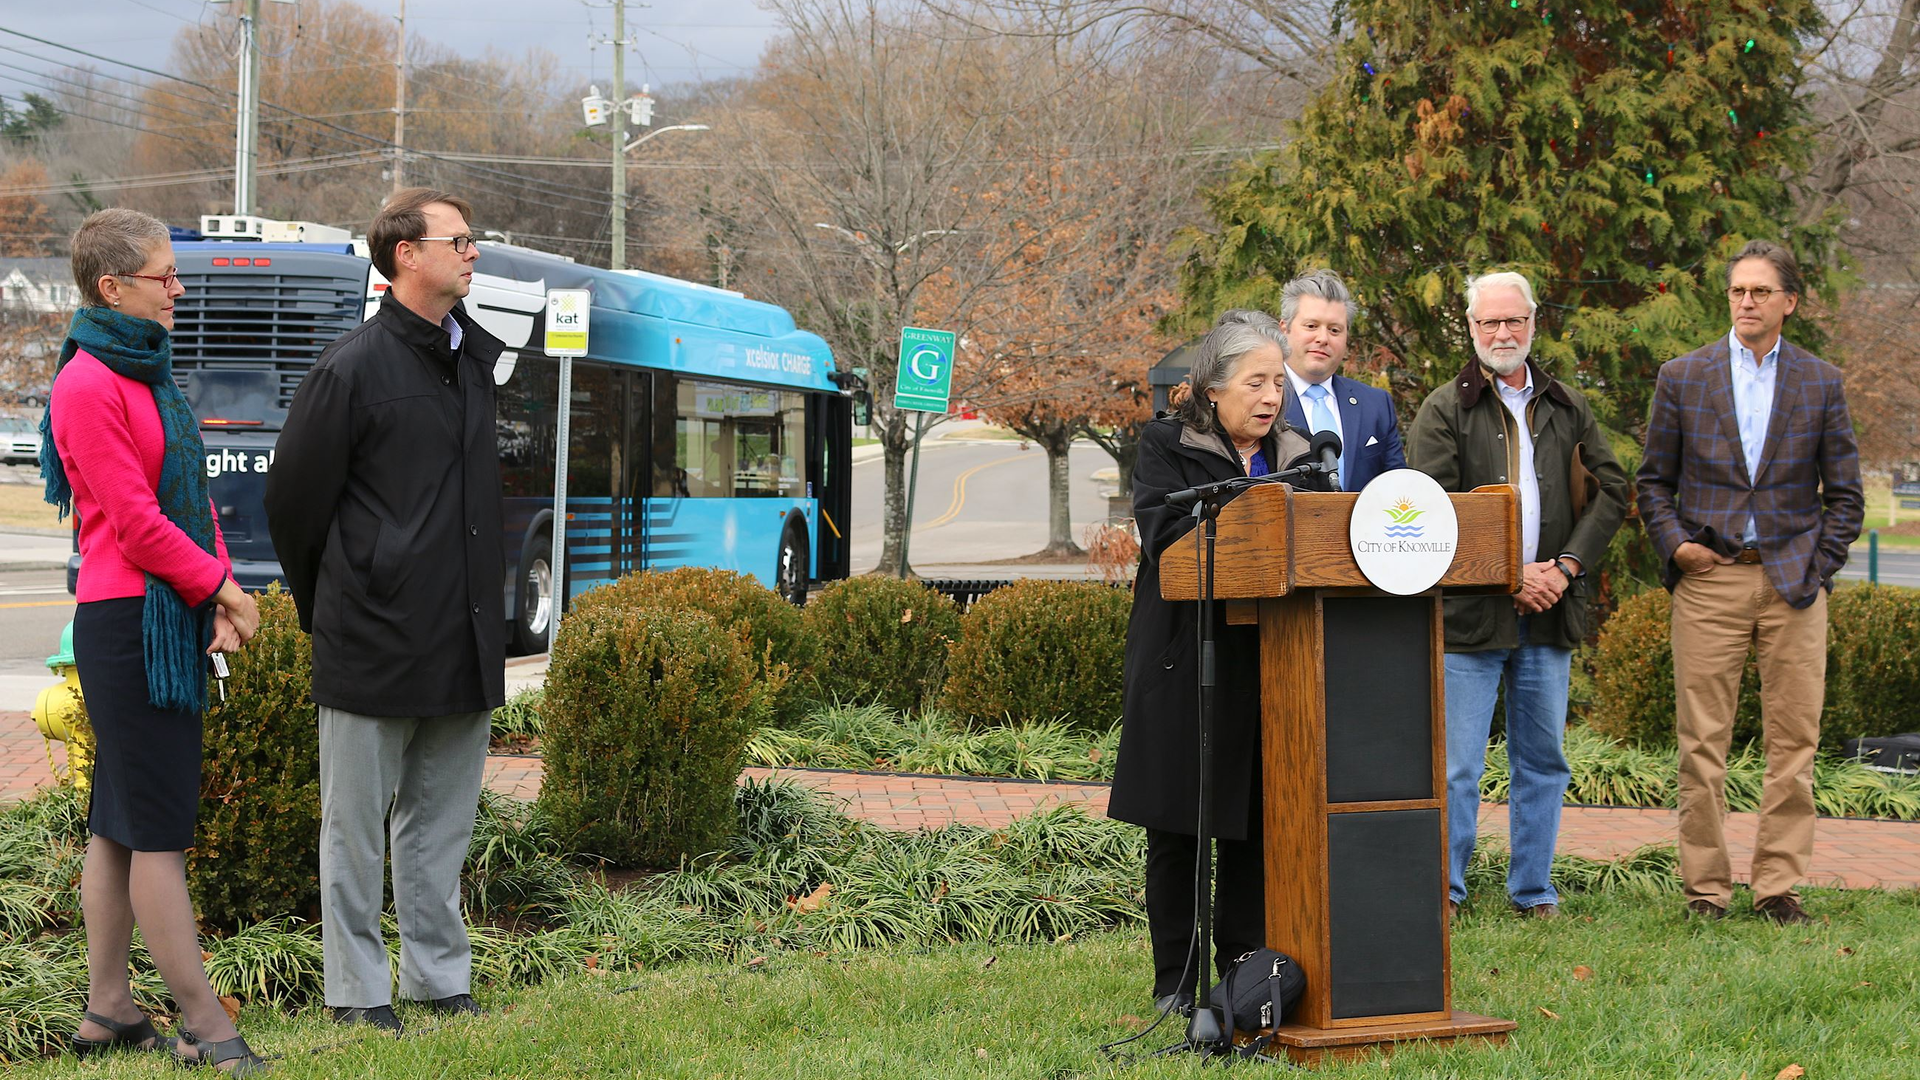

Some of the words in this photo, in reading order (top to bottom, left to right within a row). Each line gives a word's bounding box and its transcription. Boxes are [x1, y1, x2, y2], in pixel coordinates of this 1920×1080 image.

[556, 312, 579, 324] kat
[904, 332, 952, 344] GREENWAY
[745, 344, 780, 371] xcelsior
[782, 352, 812, 376] CHARGE
[911, 350, 940, 380] G
[1357, 540, 1383, 553] CITY
[1383, 542, 1397, 553] OF
[1398, 540, 1451, 553] KNOXVILLE
